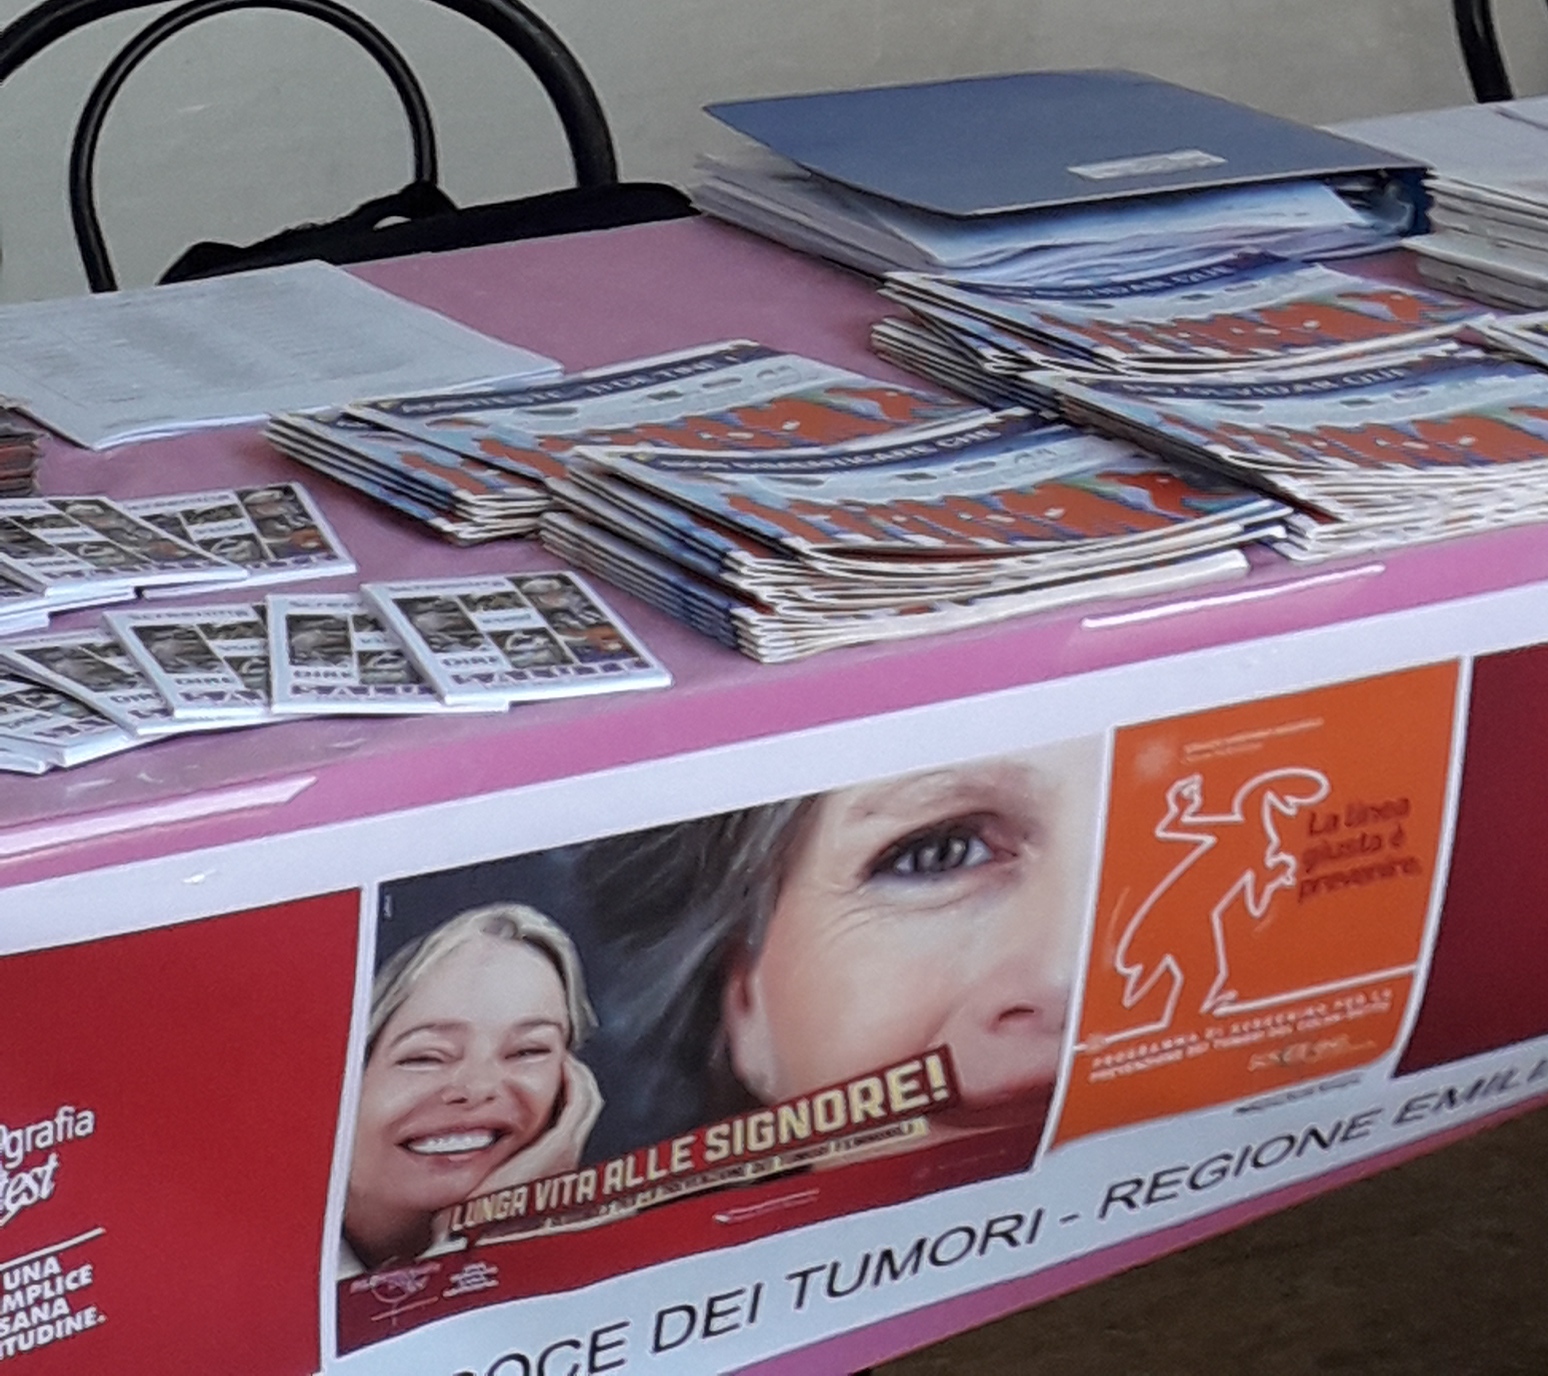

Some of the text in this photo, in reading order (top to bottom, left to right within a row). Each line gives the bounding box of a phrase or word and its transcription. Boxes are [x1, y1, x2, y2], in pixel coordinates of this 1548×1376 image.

[451, 1186, 529, 1232] LUNGA
[534, 1169, 598, 1212] VITA
[602, 1135, 698, 1195] ALLE
[703, 1054, 950, 1163] SIGNORE!
[652, 1282, 764, 1354] DEI
[785, 1208, 1045, 1310] TUMORI
[1097, 1107, 1383, 1220] REGIONE
[2, 1264, 94, 1314] MPLICE
[3, 1255, 62, 1291] UNA
[0, 1296, 71, 1339] SANA
